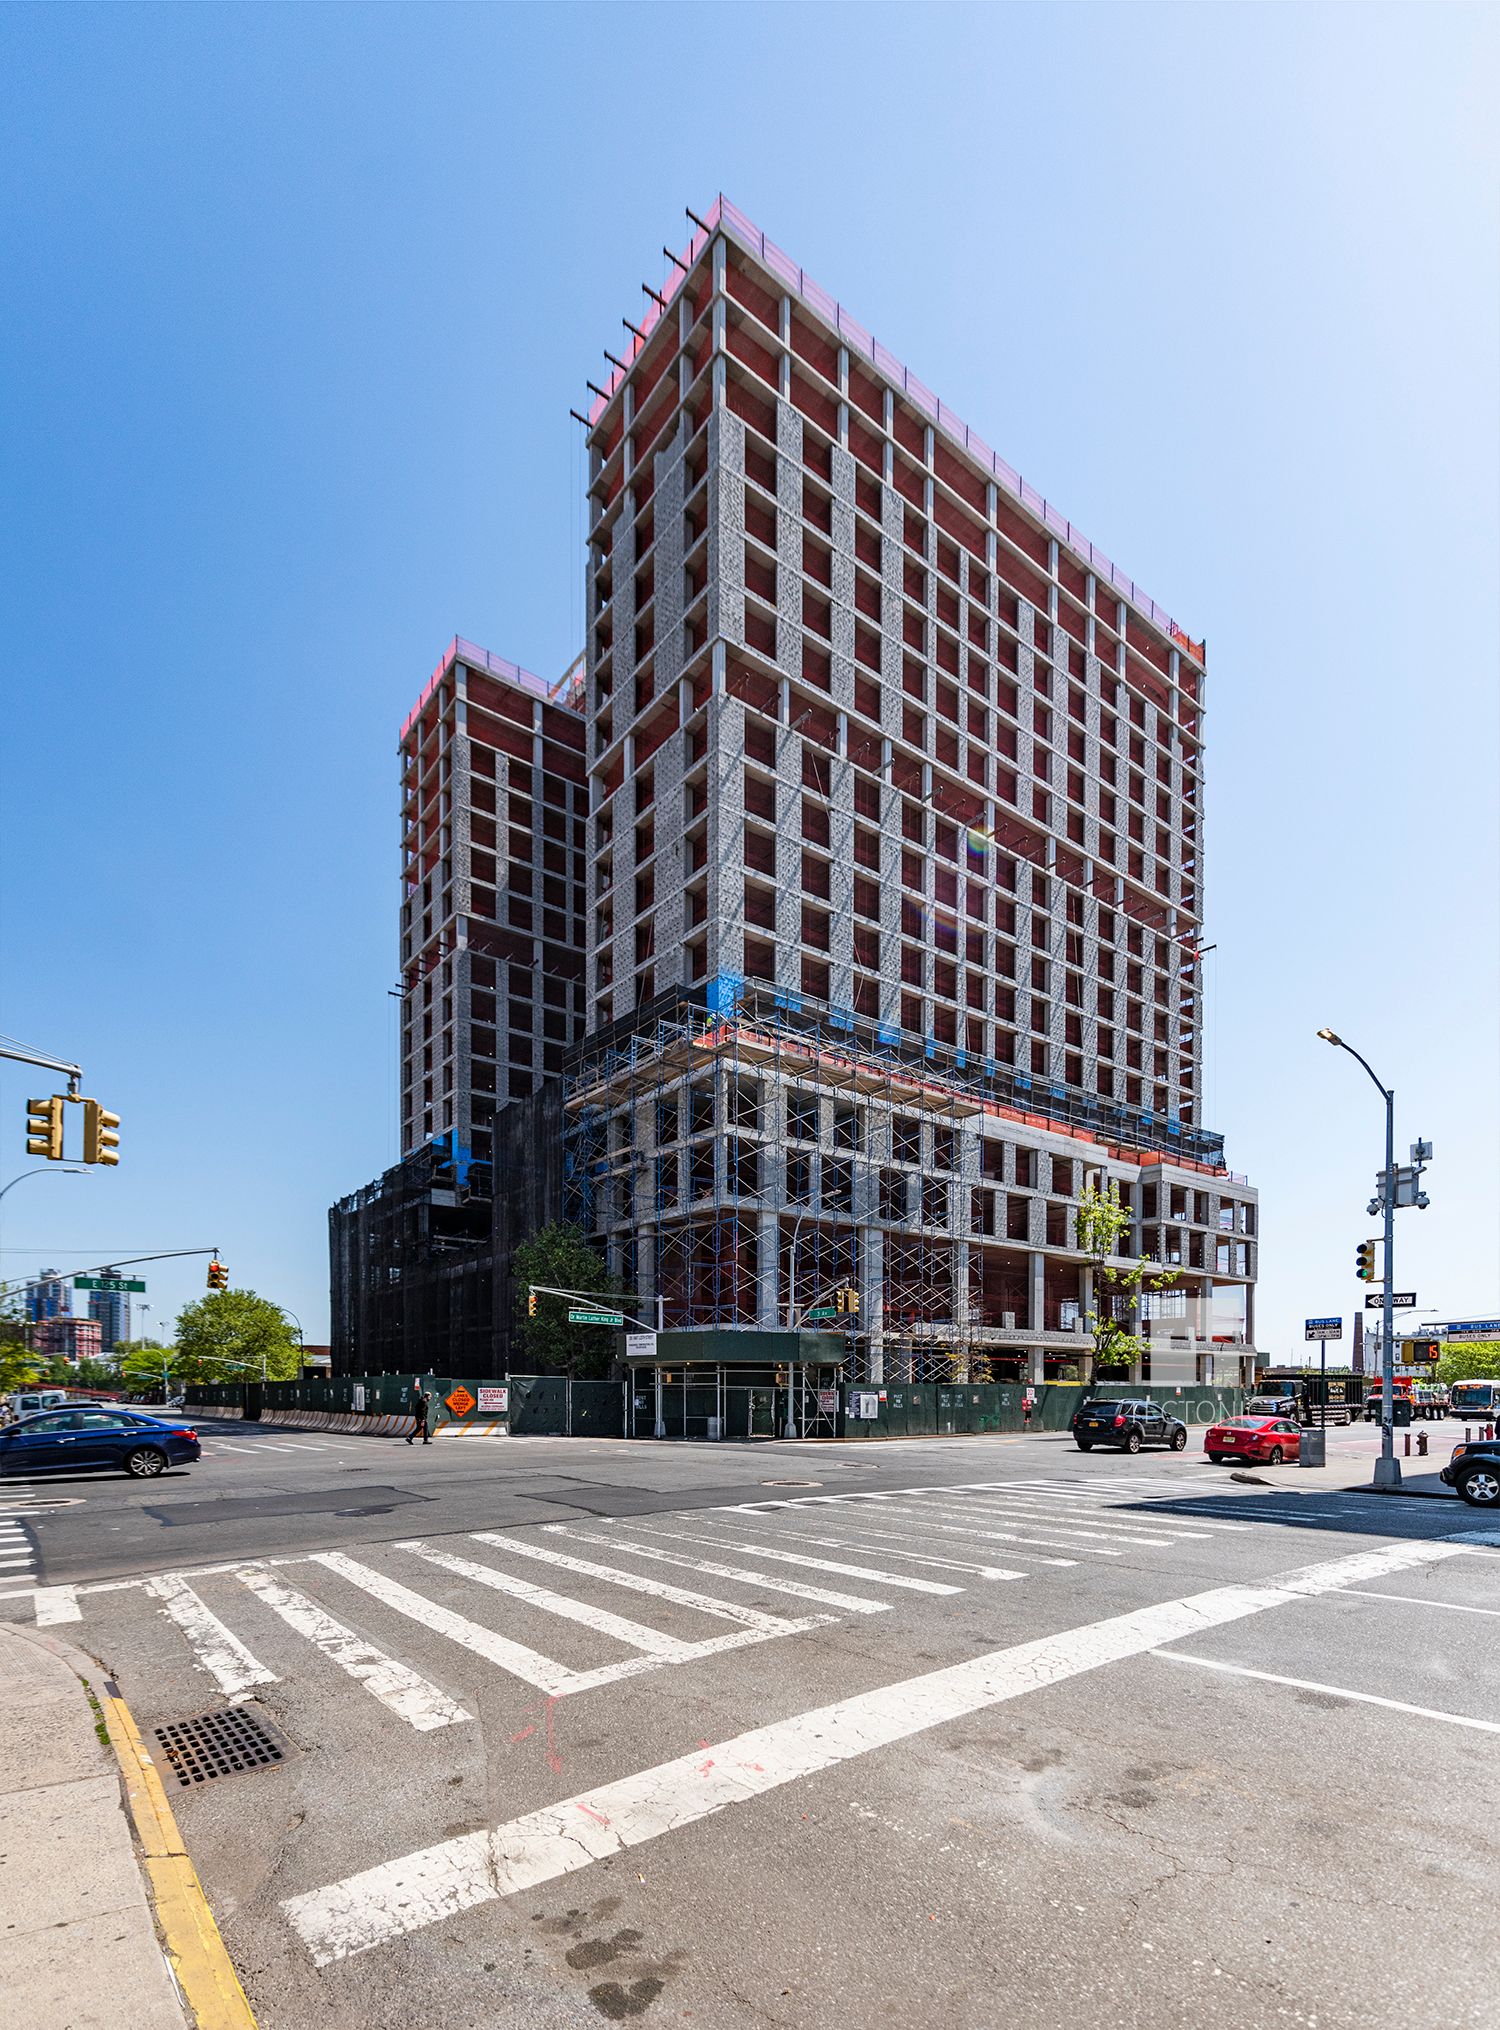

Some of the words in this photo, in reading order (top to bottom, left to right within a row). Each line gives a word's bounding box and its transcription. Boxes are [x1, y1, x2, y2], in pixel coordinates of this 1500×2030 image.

[92, 1280, 98, 1288] E
[101, 1280, 116, 1289] 125
[118, 1281, 128, 1290] St
